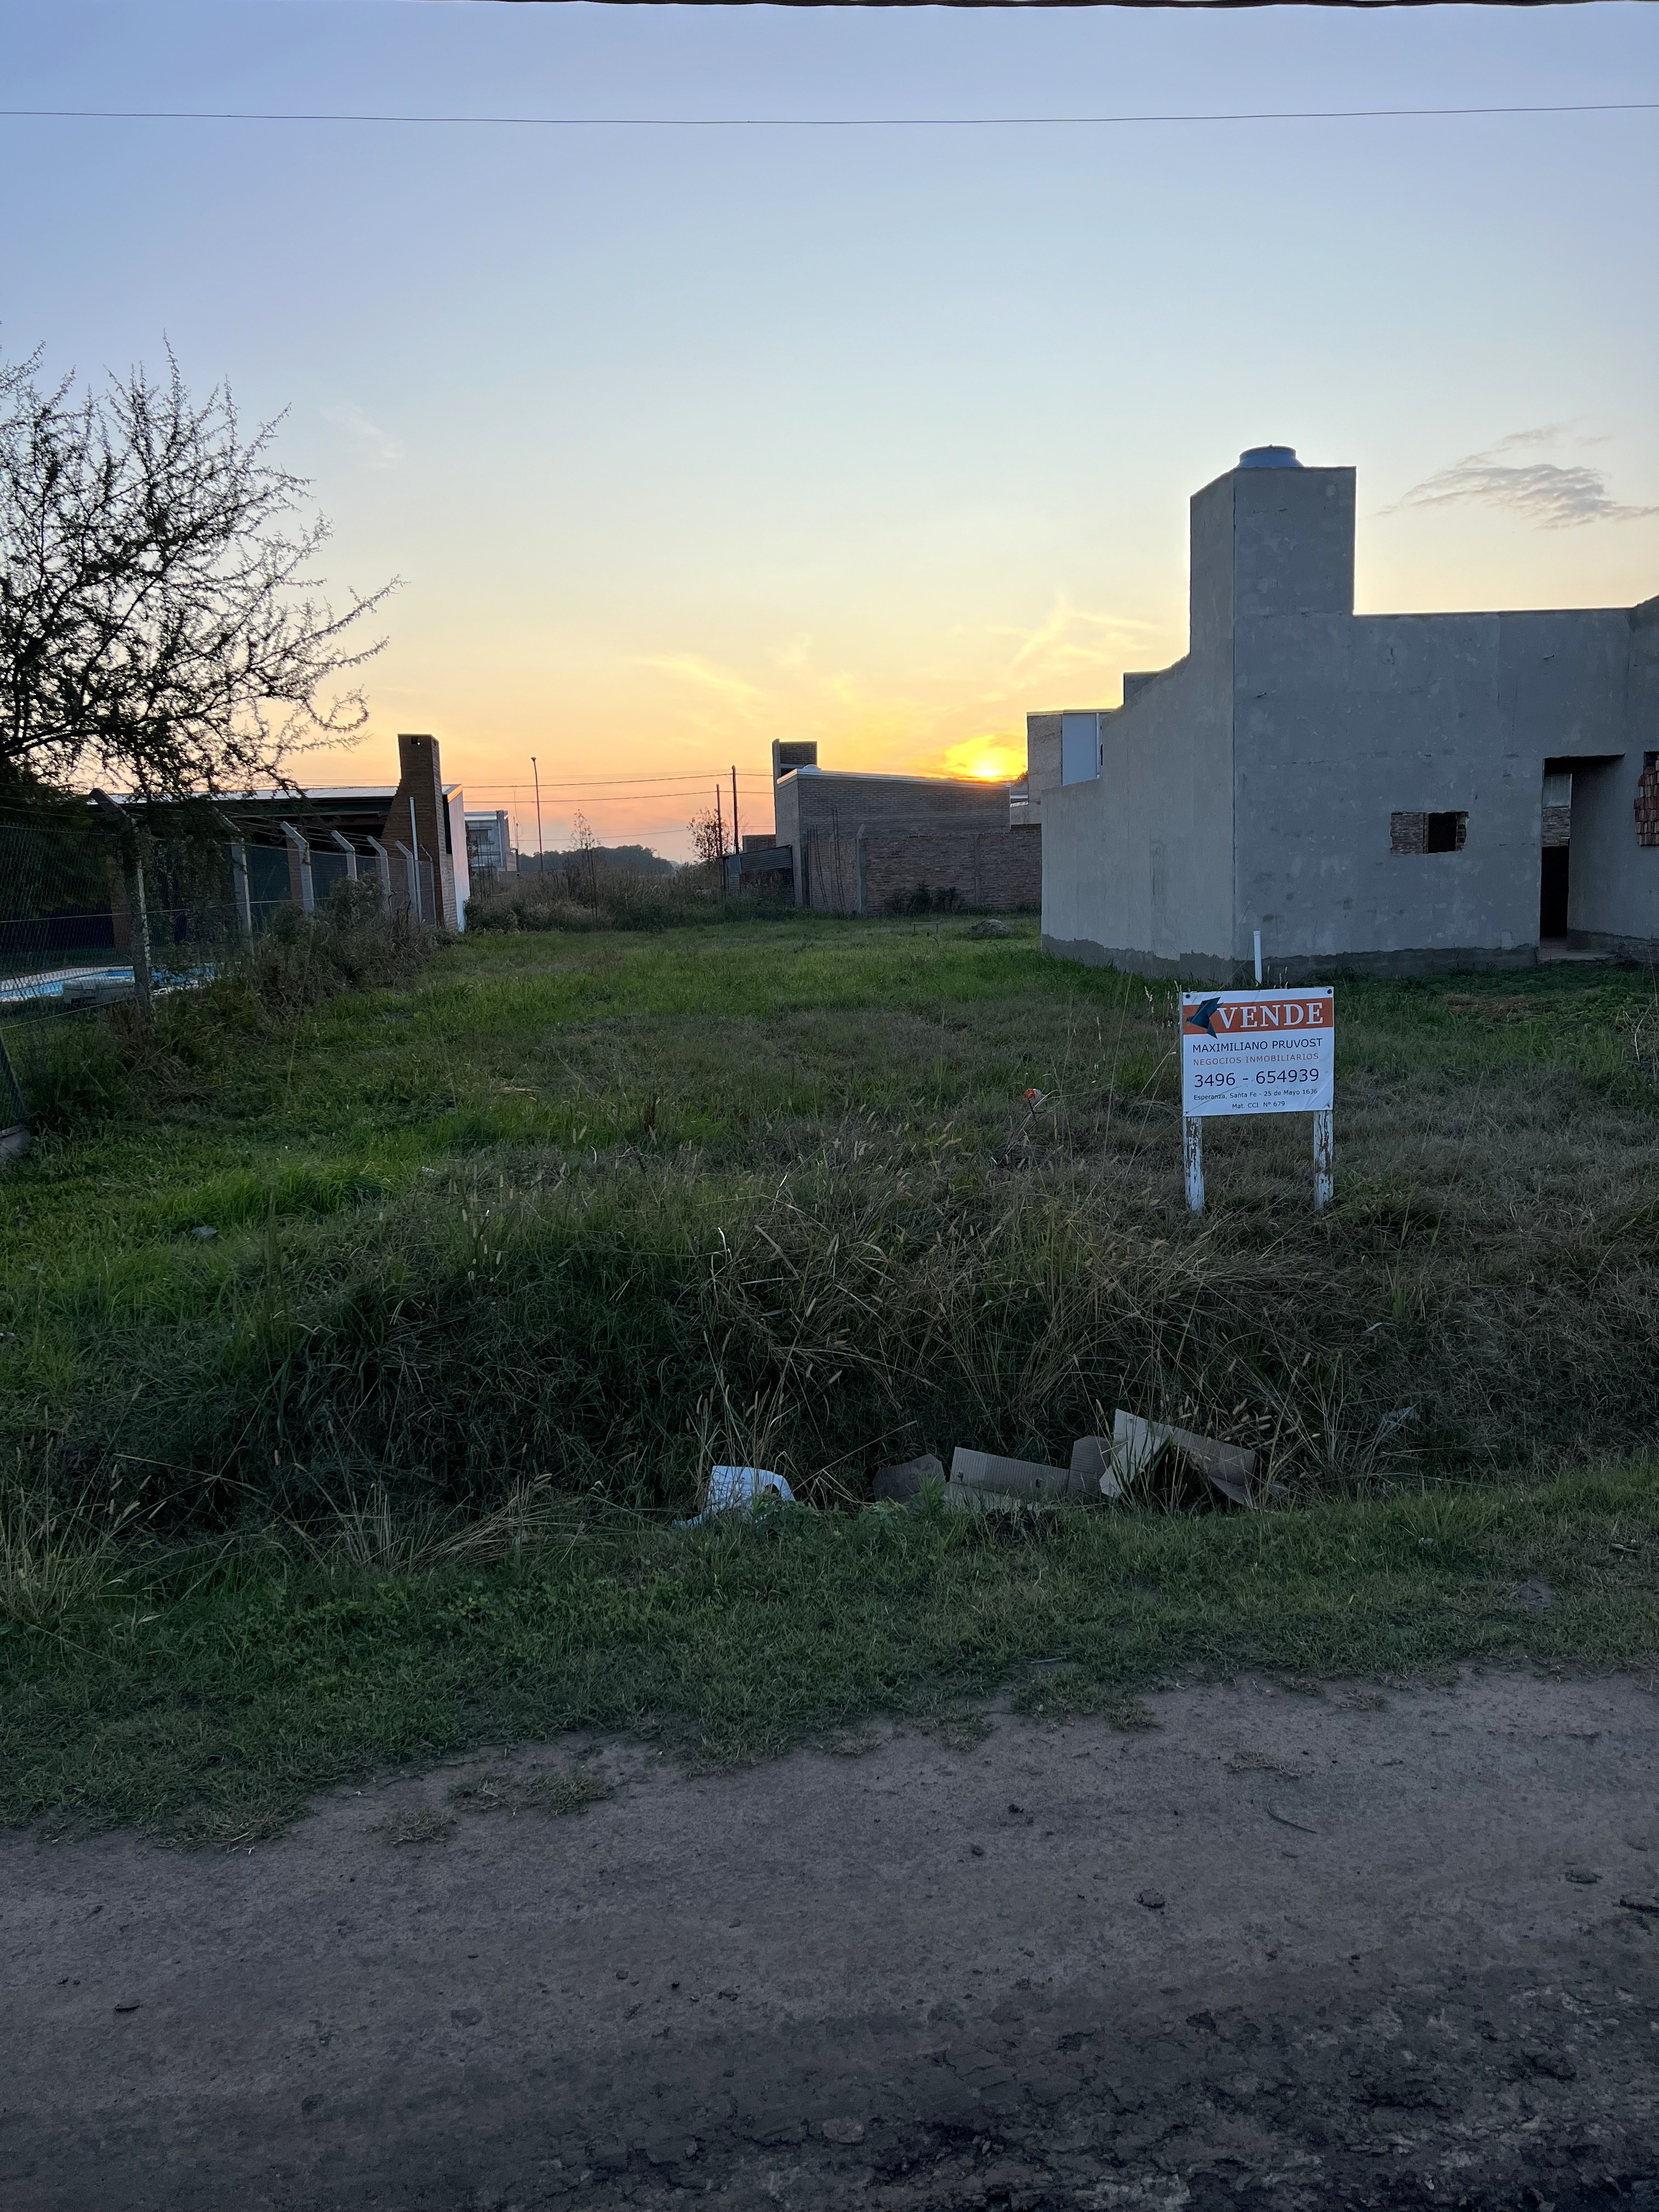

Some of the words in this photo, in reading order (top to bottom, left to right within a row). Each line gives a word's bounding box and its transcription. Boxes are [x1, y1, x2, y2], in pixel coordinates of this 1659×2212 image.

[1216, 1002, 1323, 1029] VENDE
[1193, 1041, 1268, 1053] MAXIMILIANO
[1272, 1038, 1323, 1049] PRUVOST
[1193, 1057, 1242, 1066] NEGOCIOS
[1246, 1053, 1319, 1063] INMOBILIARIOS
[1194, 1073, 1235, 1087] 3496
[1256, 1069, 1319, 1084] 654939
